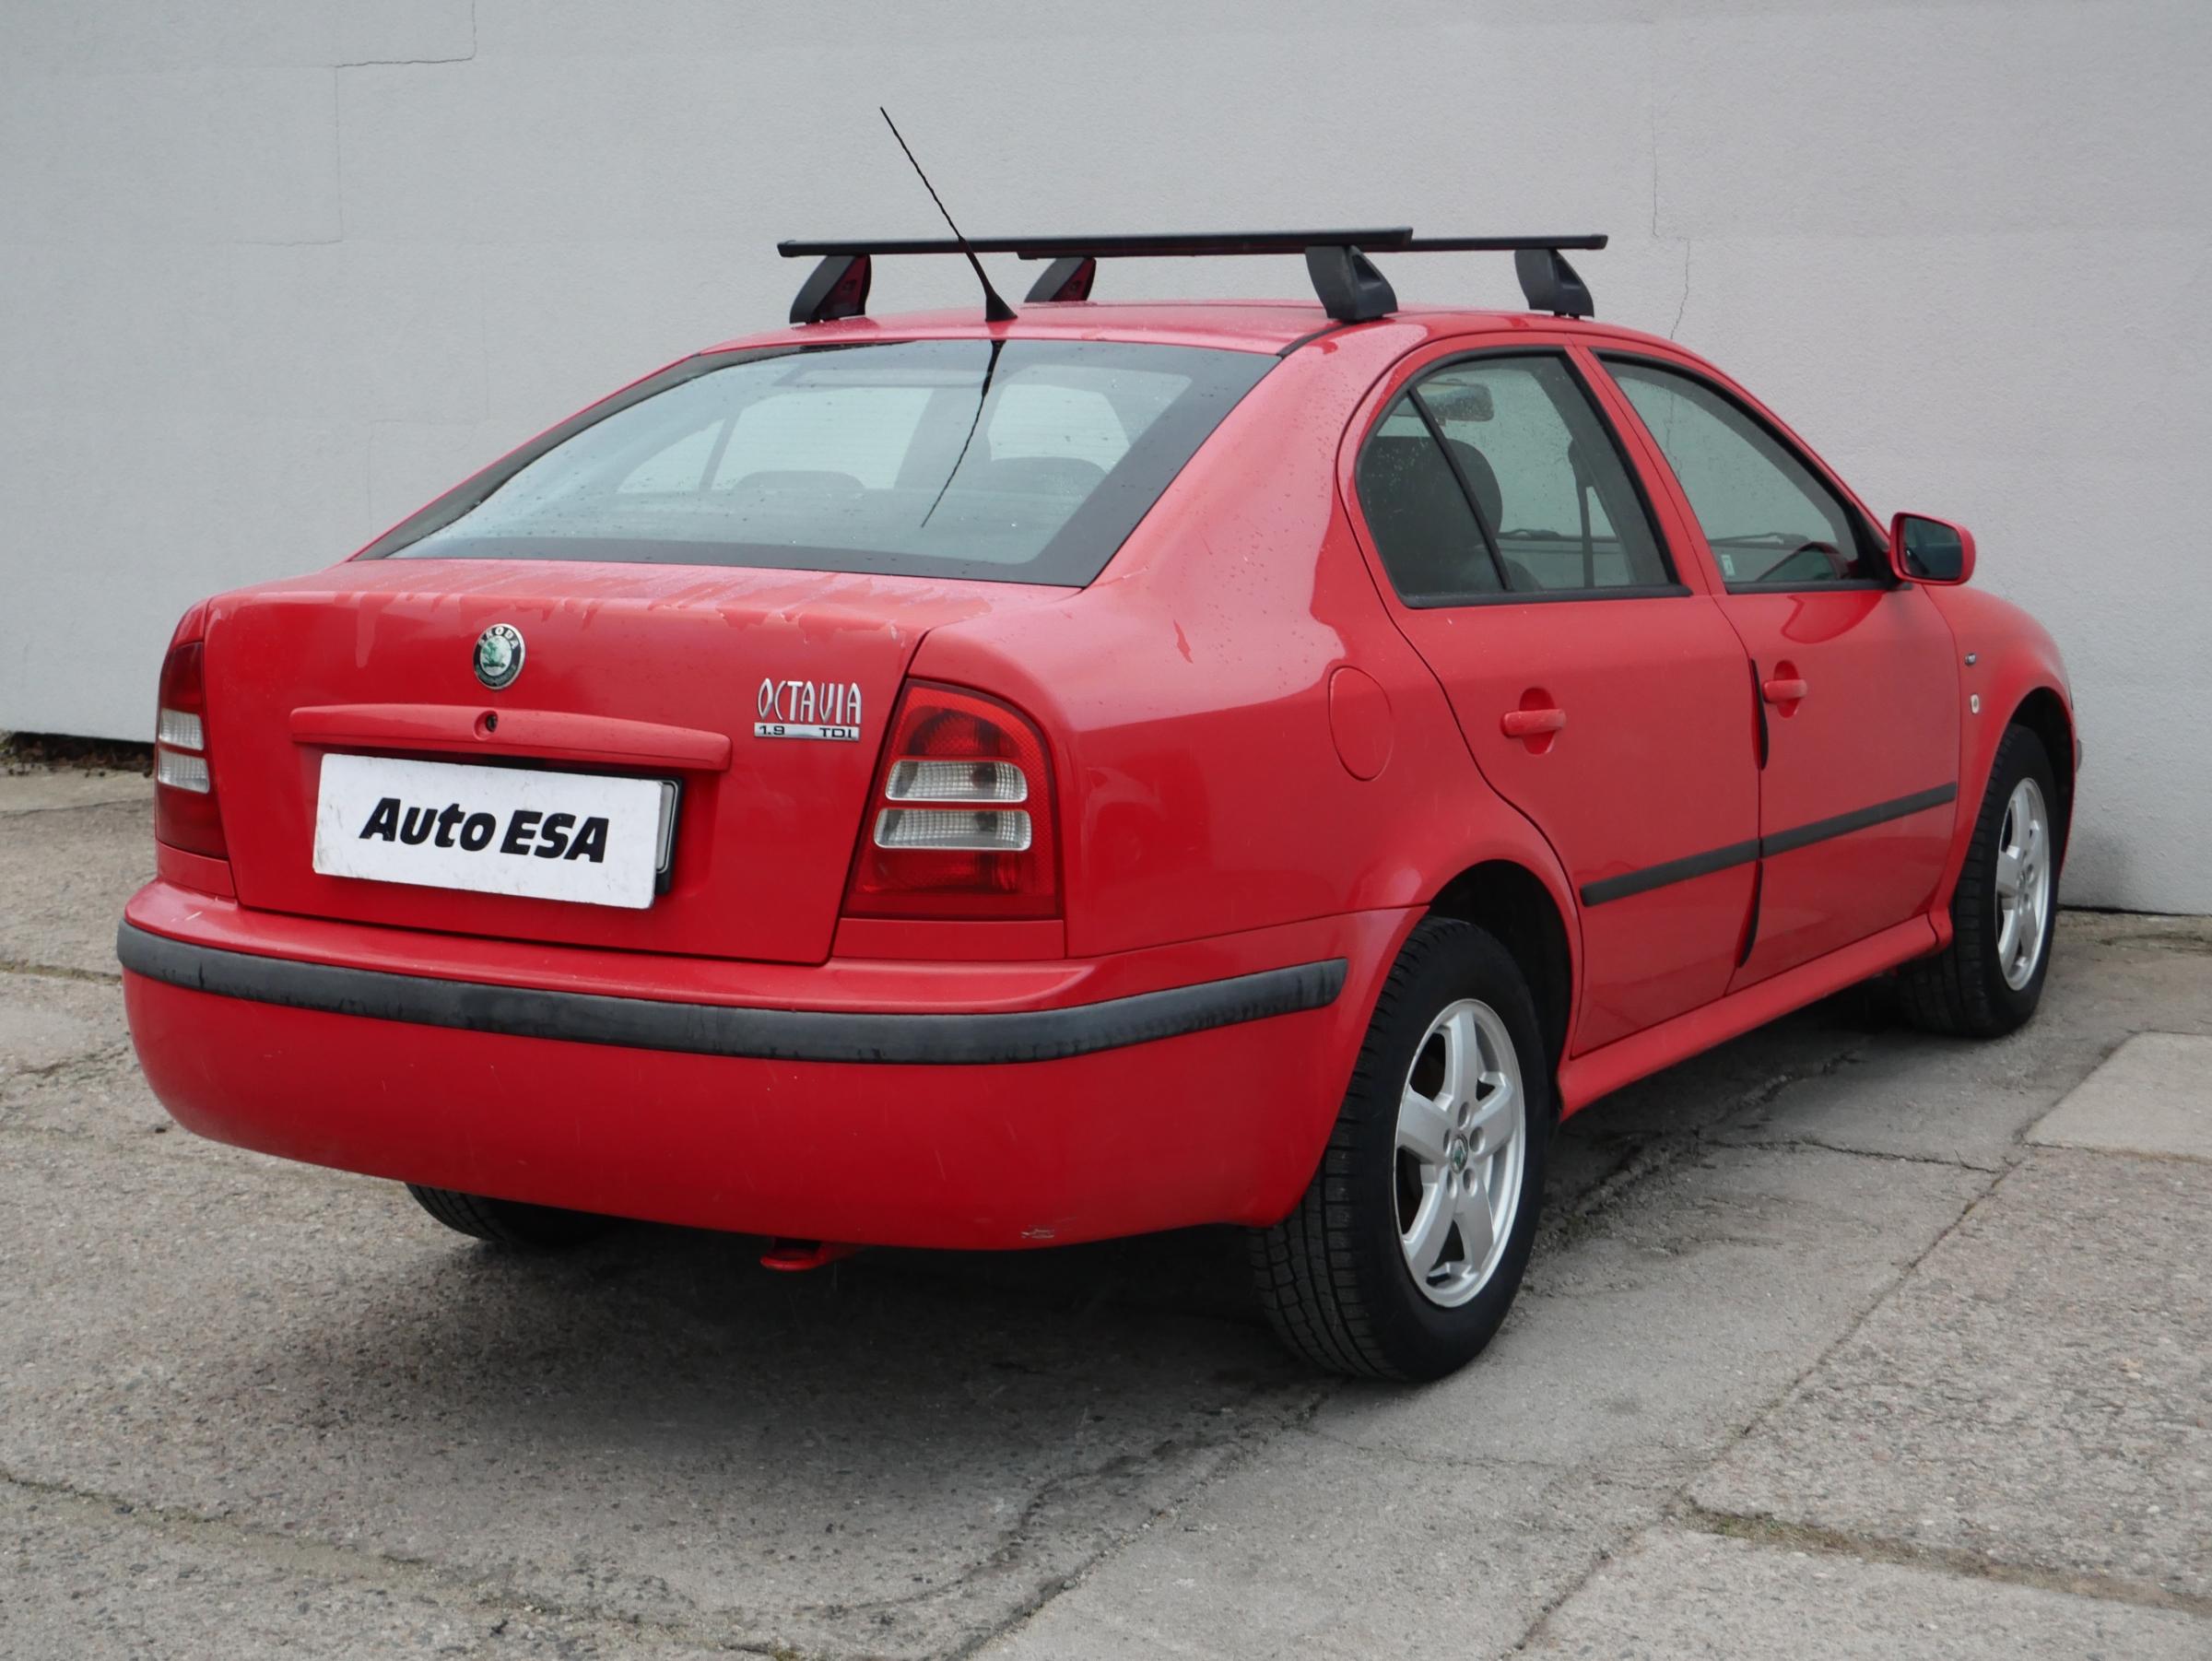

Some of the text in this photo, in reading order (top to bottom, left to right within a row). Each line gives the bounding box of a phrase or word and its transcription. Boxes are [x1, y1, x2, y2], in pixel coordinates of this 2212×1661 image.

[758, 677, 862, 724] OCTAVIA
[759, 725, 853, 738] 1.9 TDI
[359, 797, 609, 864] Auto ESA
